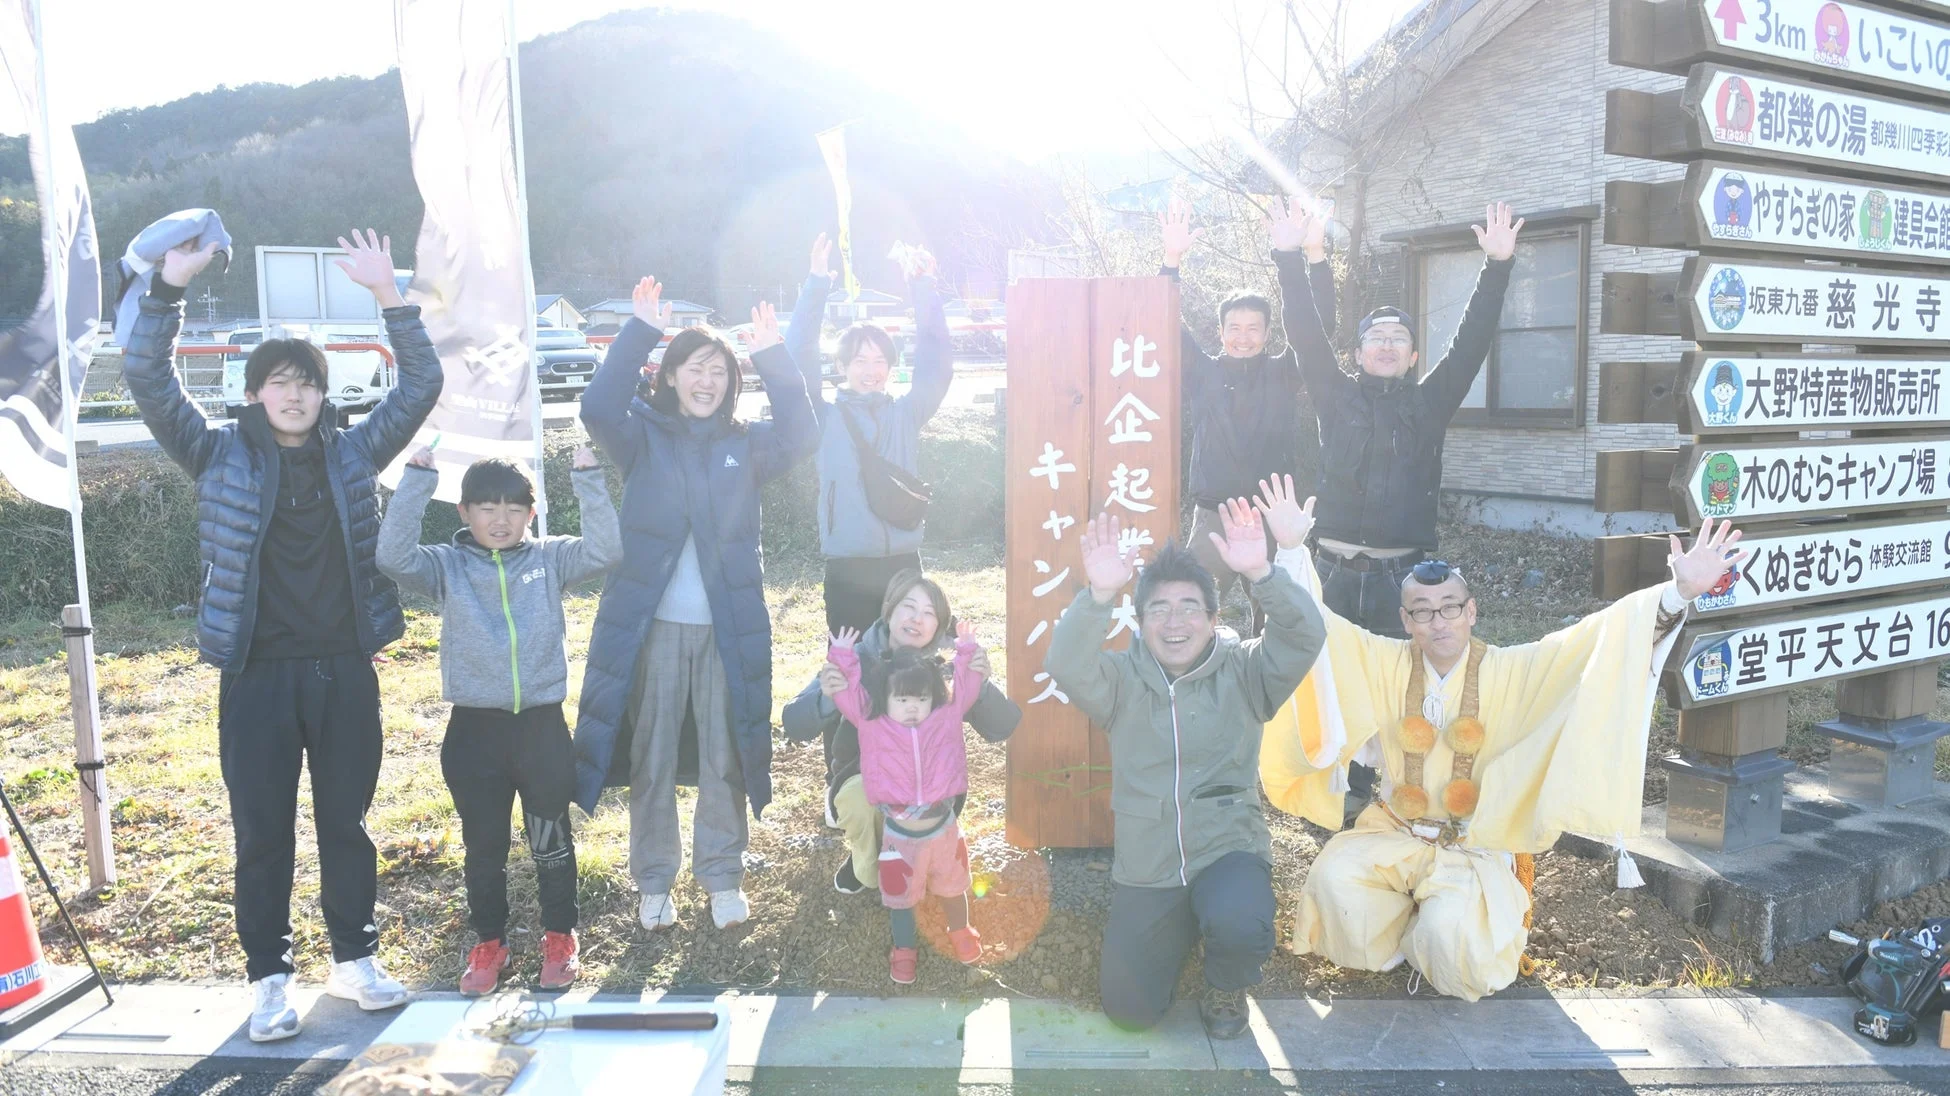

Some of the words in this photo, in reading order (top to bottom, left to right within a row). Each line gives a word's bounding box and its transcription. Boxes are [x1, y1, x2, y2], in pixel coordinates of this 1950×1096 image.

[1758, 86, 1867, 156] 都幾の湯
[1870, 118, 1950, 158] 都幾川四季彩
[1712, 223, 1753, 238] やすらぎさん
[1753, 180, 1856, 241] やすらぎの家
[1858, 235, 1892, 250] しょうじくん
[1748, 286, 1819, 316] 坂東九番
[1826, 278, 1942, 332] 慈光寺
[1708, 411, 1738, 424] 大野くん
[1745, 366, 1941, 419] 大野特産物販売所
[1741, 448, 1936, 509] 木のむらキャンプ場
[1703, 503, 1736, 516] ウッドマン
[1743, 538, 1863, 596] くぬぎむら
[1869, 538, 1932, 571] 体験交流館
[1698, 593, 1736, 609] ひもかわさん
[1736, 610, 1914, 686] 堂平天文台
[1696, 682, 1728, 697] ドームくん
